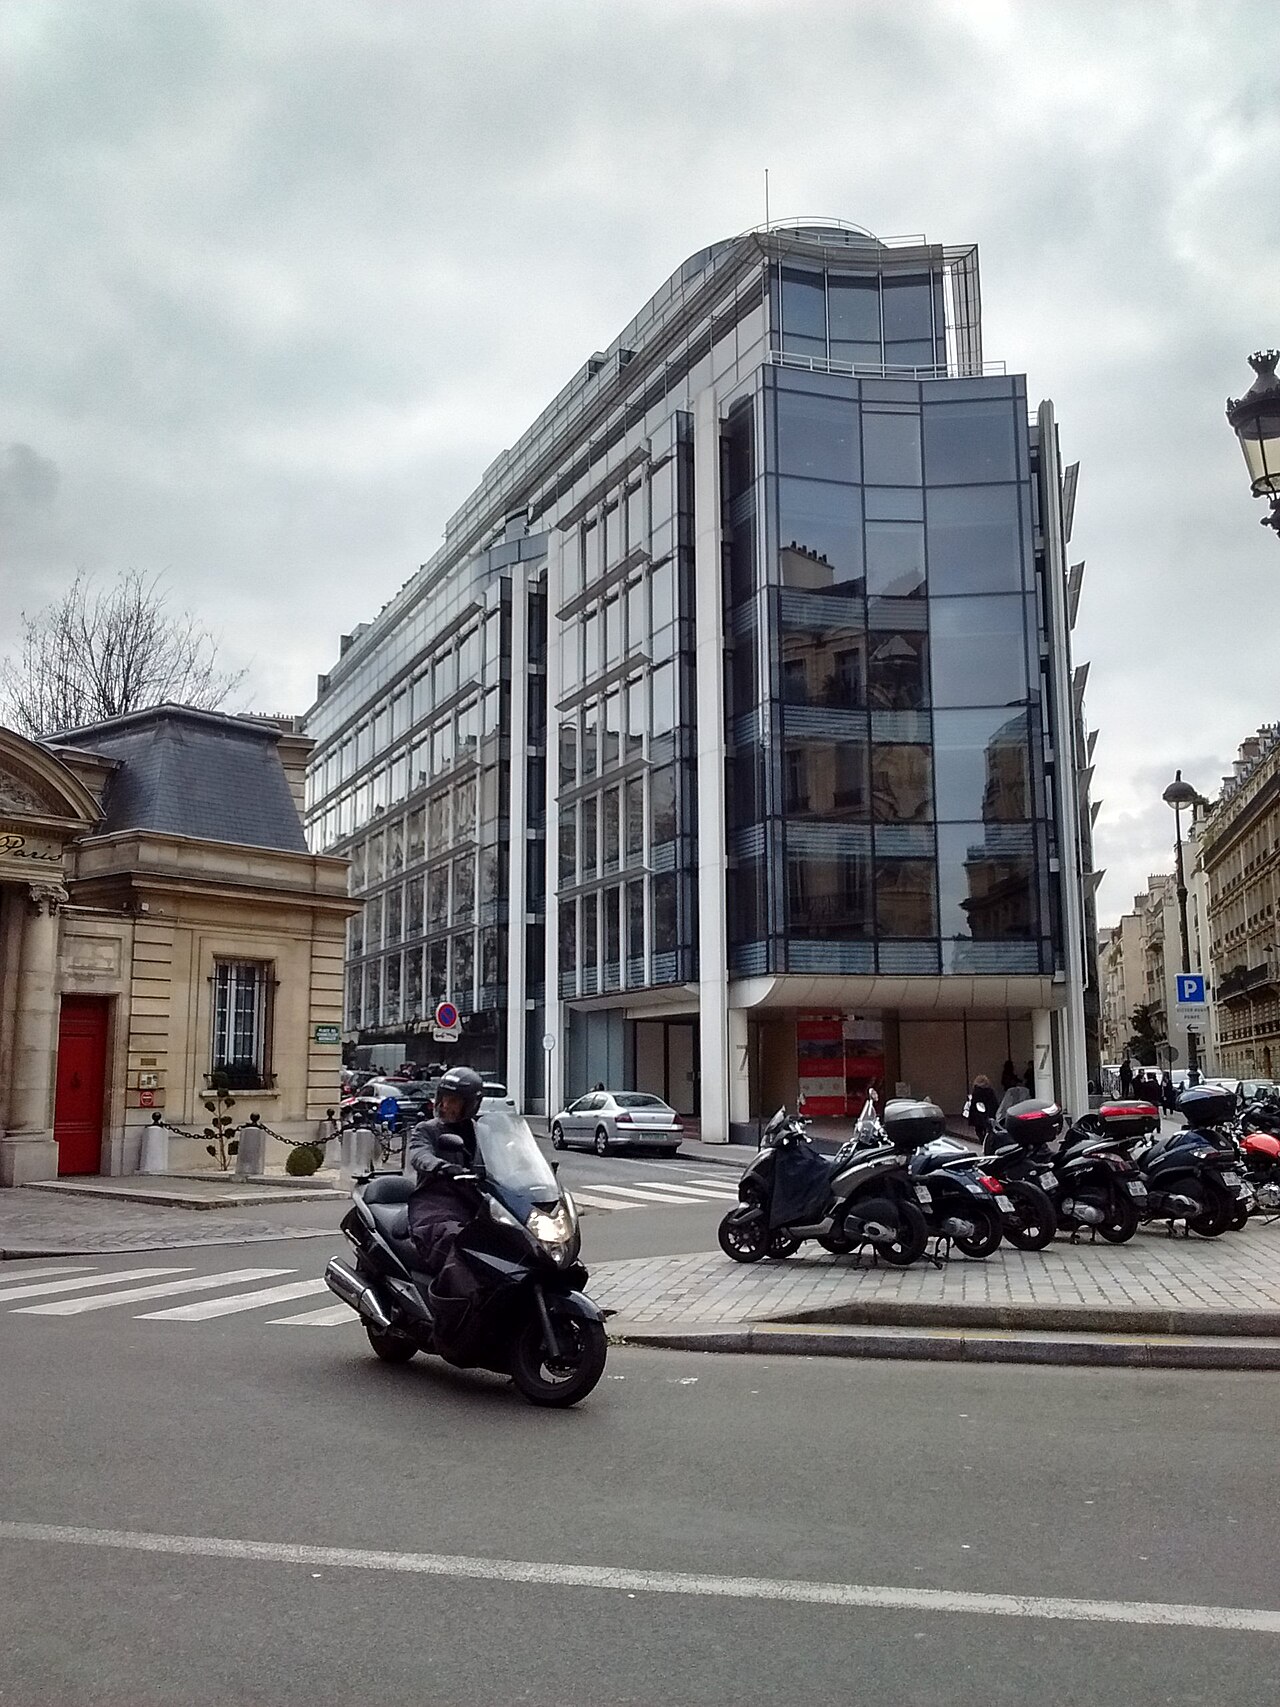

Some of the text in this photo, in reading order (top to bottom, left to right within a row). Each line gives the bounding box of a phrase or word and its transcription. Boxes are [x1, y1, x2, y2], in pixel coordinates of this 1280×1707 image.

[1184, 980, 1197, 998] P
[736, 1044, 748, 1071] 7
[1036, 1044, 1050, 1070] 7
